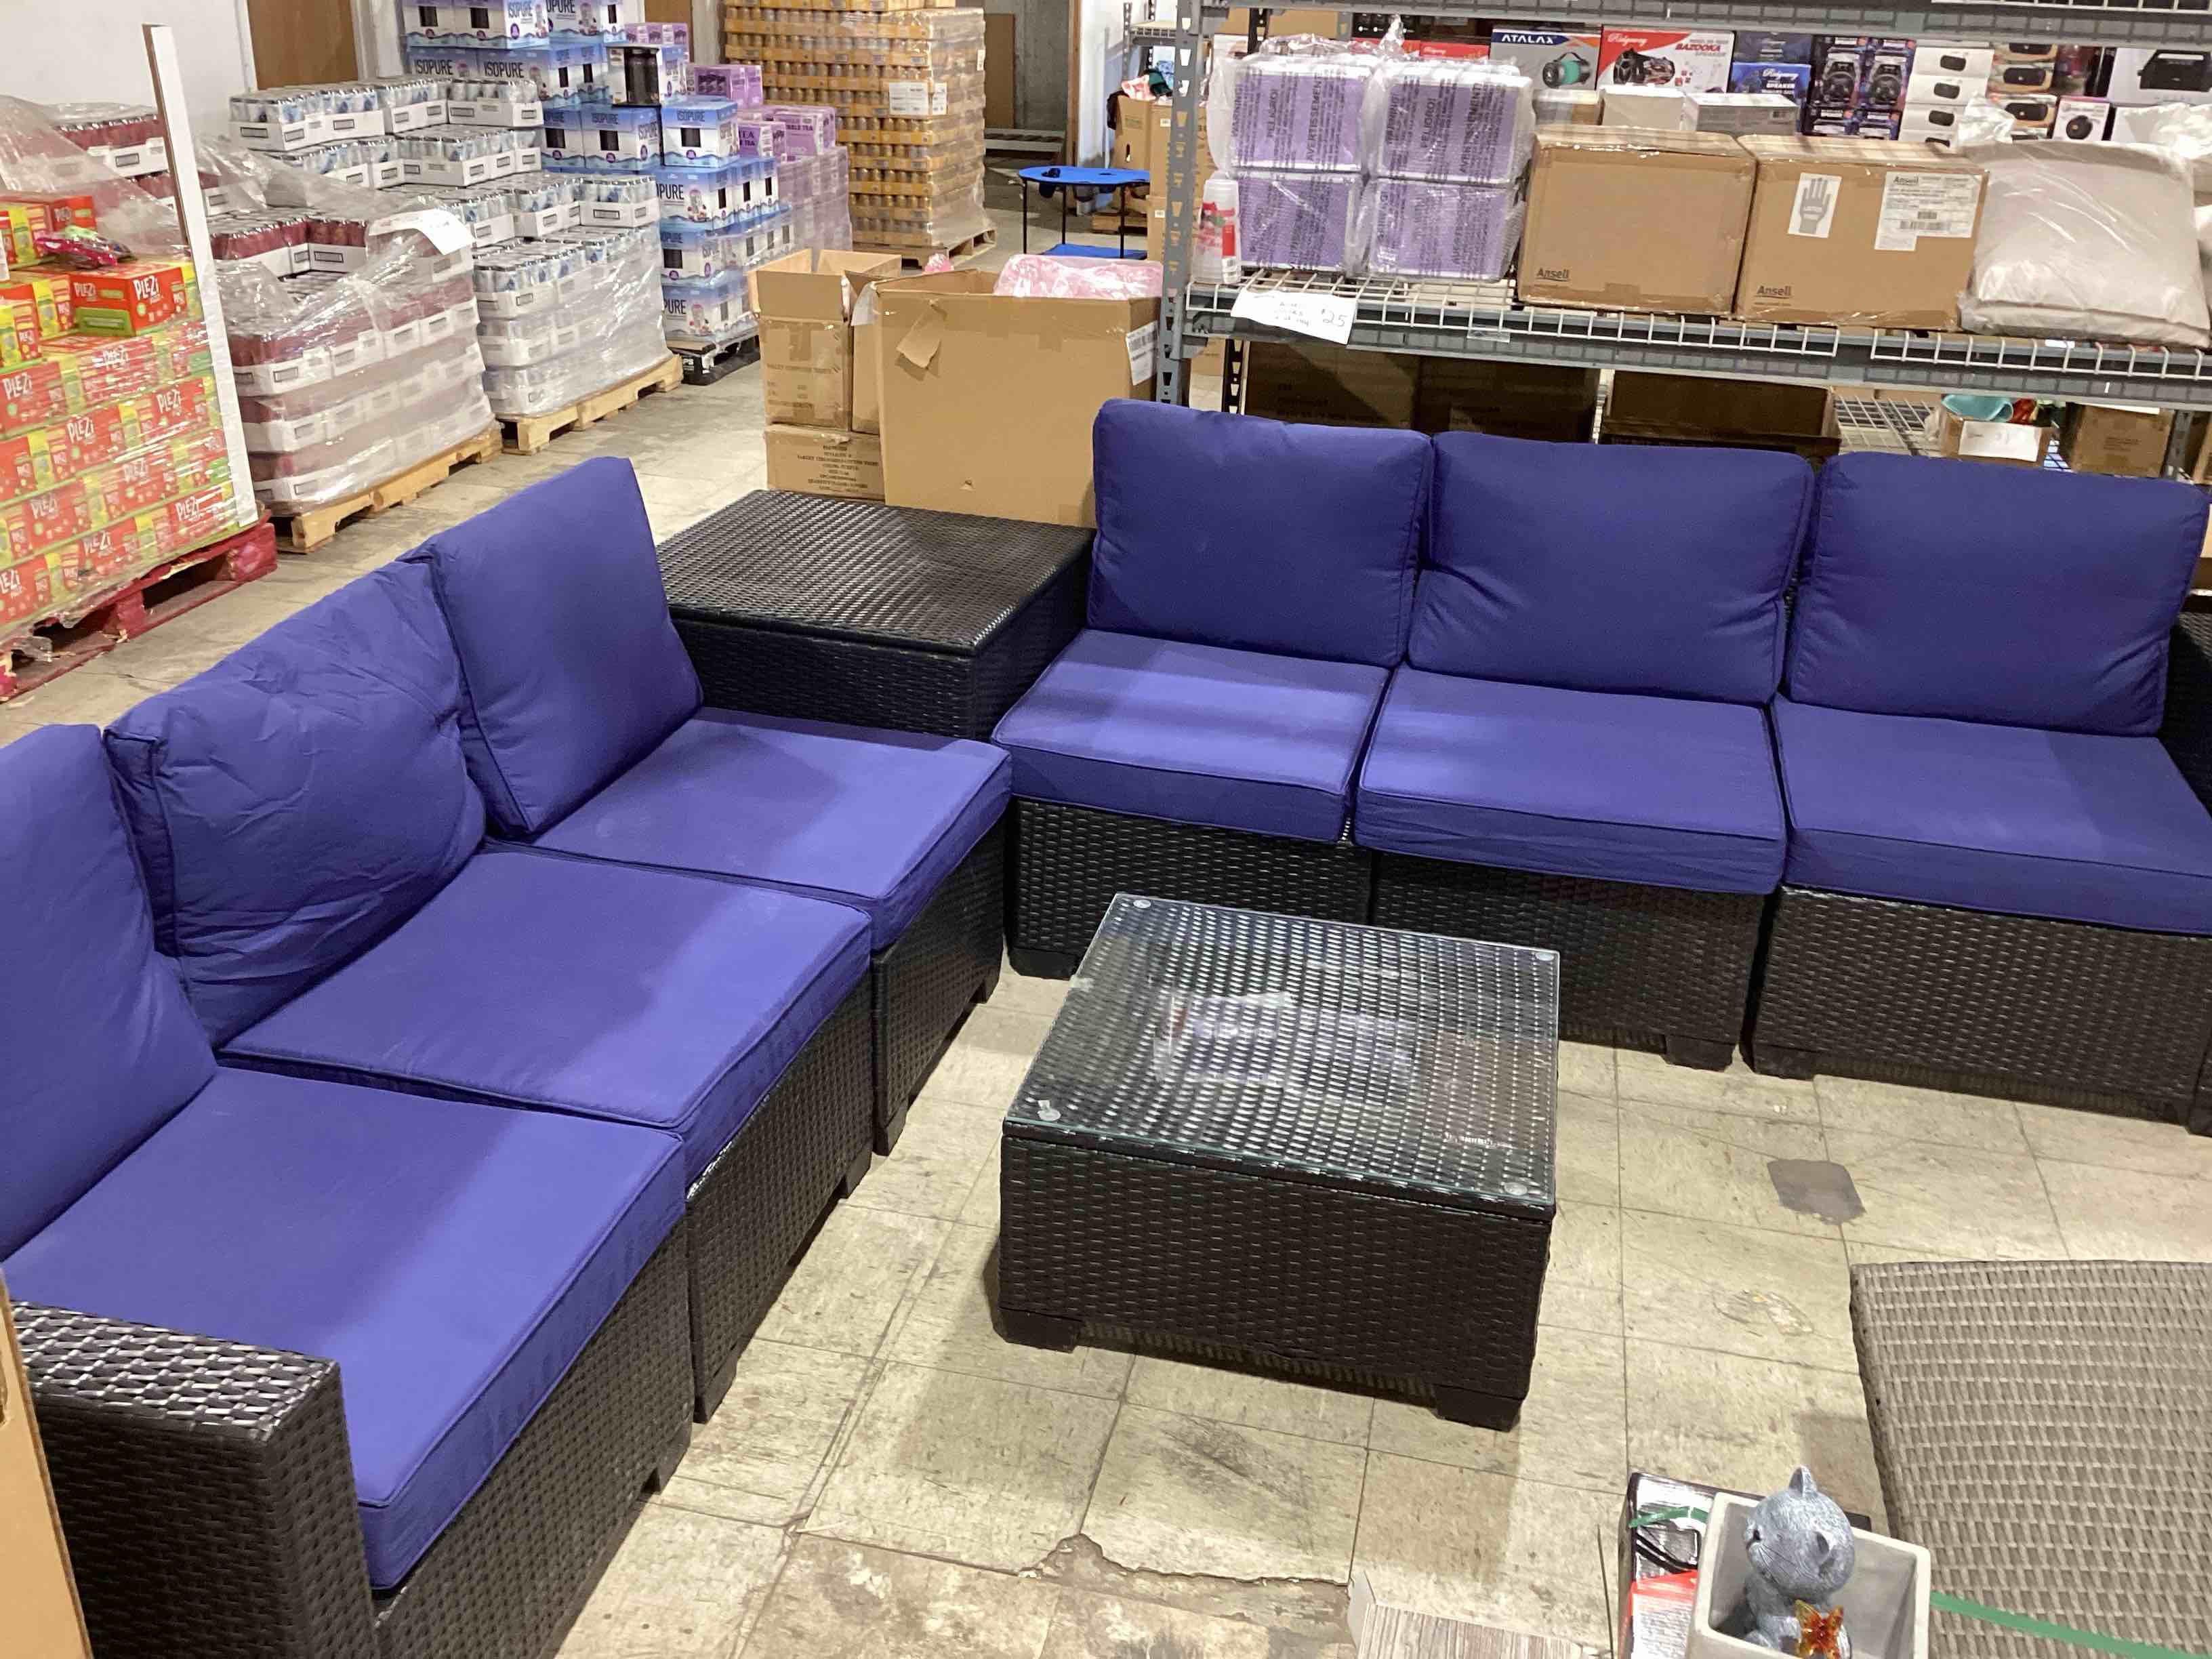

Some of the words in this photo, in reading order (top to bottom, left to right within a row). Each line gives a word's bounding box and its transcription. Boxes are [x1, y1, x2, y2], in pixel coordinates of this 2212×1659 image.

[546, 0, 575, 14] OPURE
[415, 59, 453, 75] ISOPURE
[483, 61, 525, 78] ISOPURE
[656, 183, 684, 200] PURE
[1536, 268, 1570, 279] Ansell
[132, 274, 160, 301] PLEZi
[1757, 285, 1792, 296] Ansell
[1, 373, 33, 401] PLEZi
[156, 388, 181, 414] PLEZi
[67, 417, 94, 444] PLEZi
[0, 569, 21, 594] LEZi
